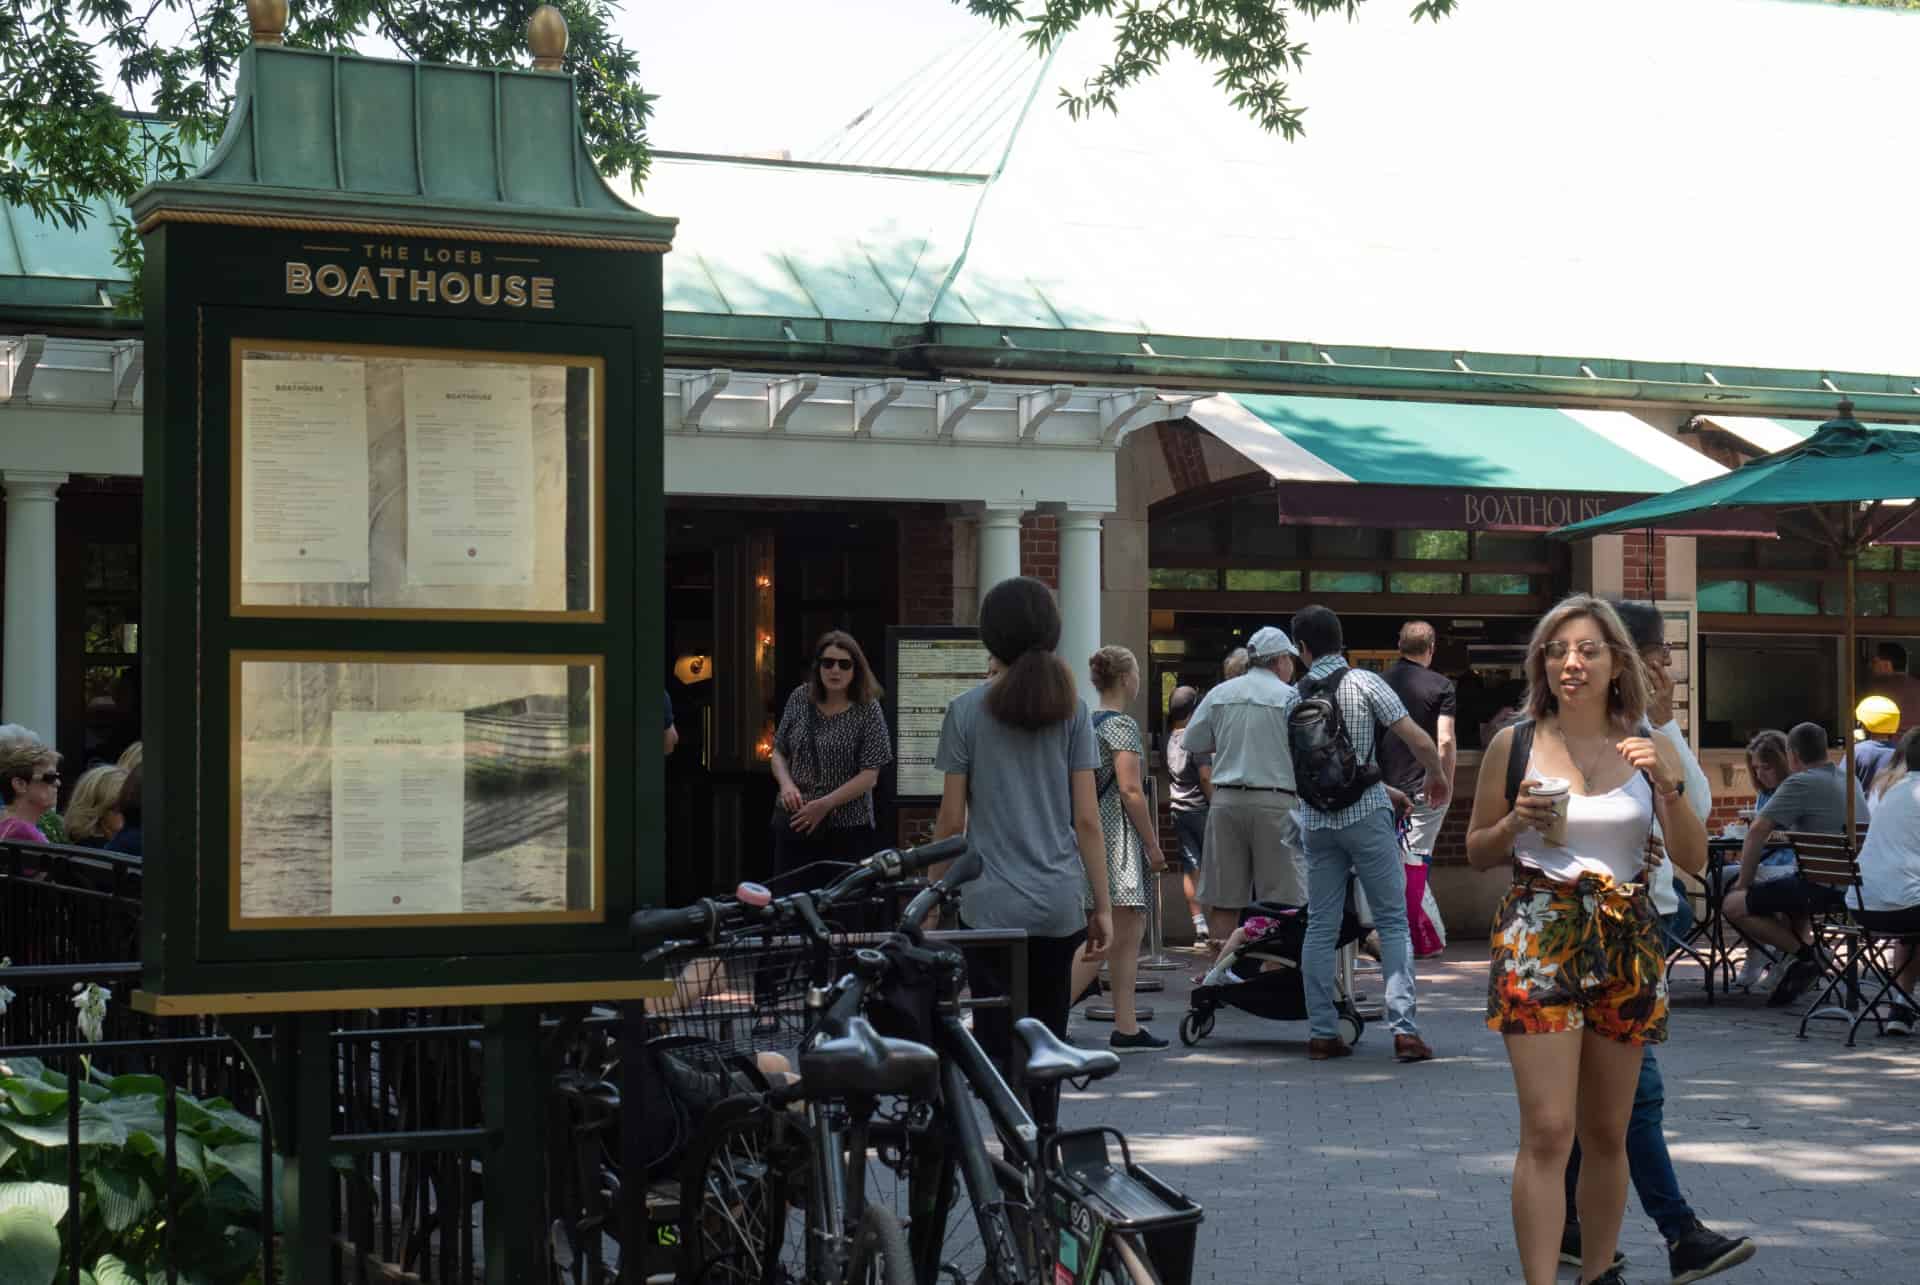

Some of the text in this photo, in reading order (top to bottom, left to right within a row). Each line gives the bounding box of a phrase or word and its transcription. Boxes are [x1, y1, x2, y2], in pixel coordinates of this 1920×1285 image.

[363, 244, 483, 264] THE LOEB
[285, 262, 556, 309] BOATHOUSE
